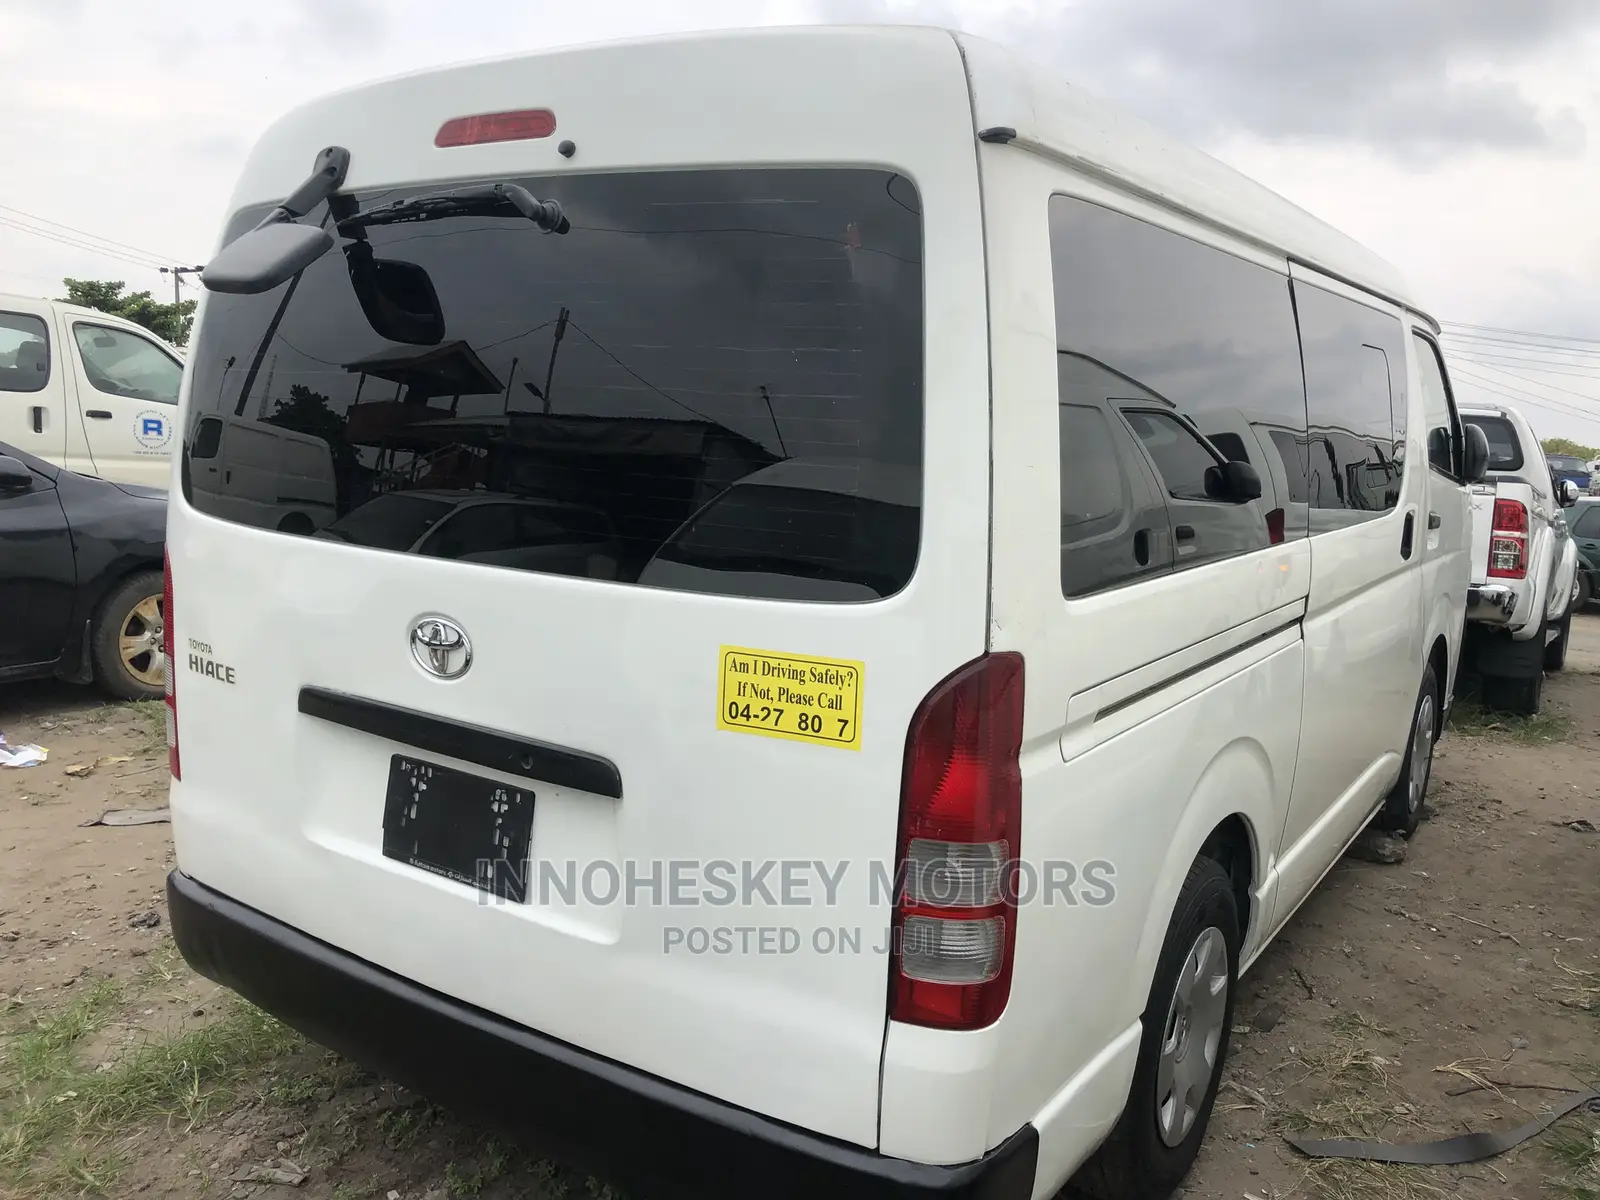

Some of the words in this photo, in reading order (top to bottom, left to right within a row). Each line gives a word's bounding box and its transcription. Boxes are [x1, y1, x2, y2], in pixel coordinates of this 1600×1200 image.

[143, 418, 163, 437] R
[188, 638, 213, 655] TOYOTA
[188, 653, 236, 685] HIACE
[729, 657, 749, 674] Am
[752, 659, 759, 675] I
[761, 661, 806, 685] Driving
[809, 666, 853, 690] Safely?
[736, 680, 748, 697] If
[749, 682, 774, 704] Not,
[777, 686, 815, 707] Please
[817, 691, 843, 711] Call
